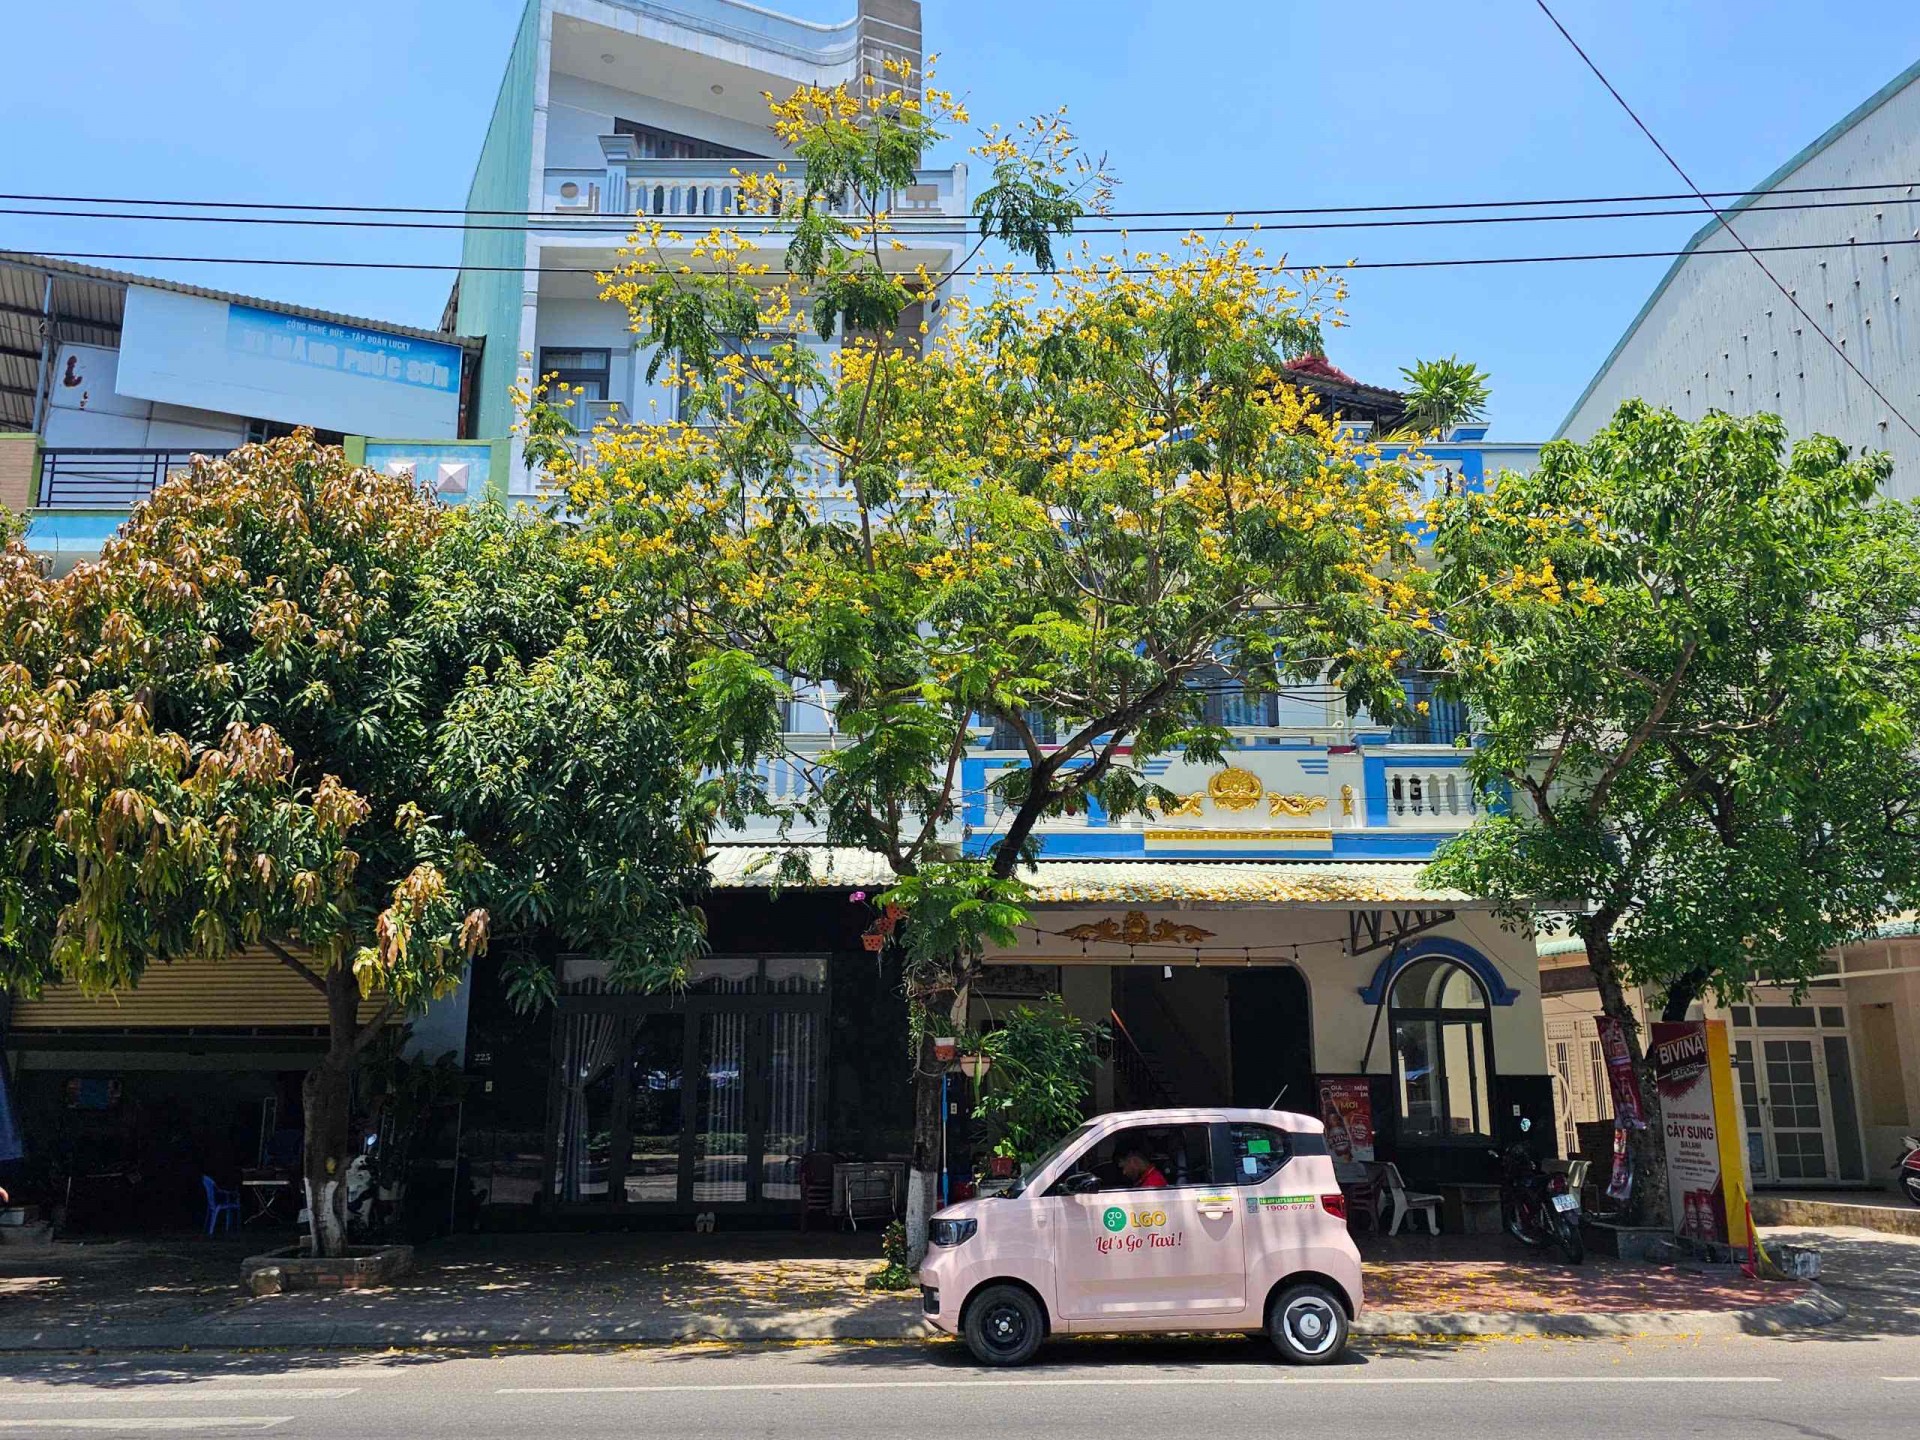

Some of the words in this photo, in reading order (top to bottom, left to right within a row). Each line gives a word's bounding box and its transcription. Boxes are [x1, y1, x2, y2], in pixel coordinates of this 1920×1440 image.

[287, 320, 306, 331] CÔNG
[389, 340, 411, 351] LUCKY
[407, 360, 449, 388] SƠN
[1660, 1034, 1705, 1065] BIVINA
[1667, 1121, 1685, 1138] CÂY
[1687, 1125, 1714, 1140] SUNG
[1266, 1204, 1289, 1212] 1900
[1291, 1203, 1315, 1211] 6779
[1130, 1210, 1167, 1228] LGO
[1096, 1235, 1123, 1254] Let's
[1126, 1234, 1143, 1252] Go
